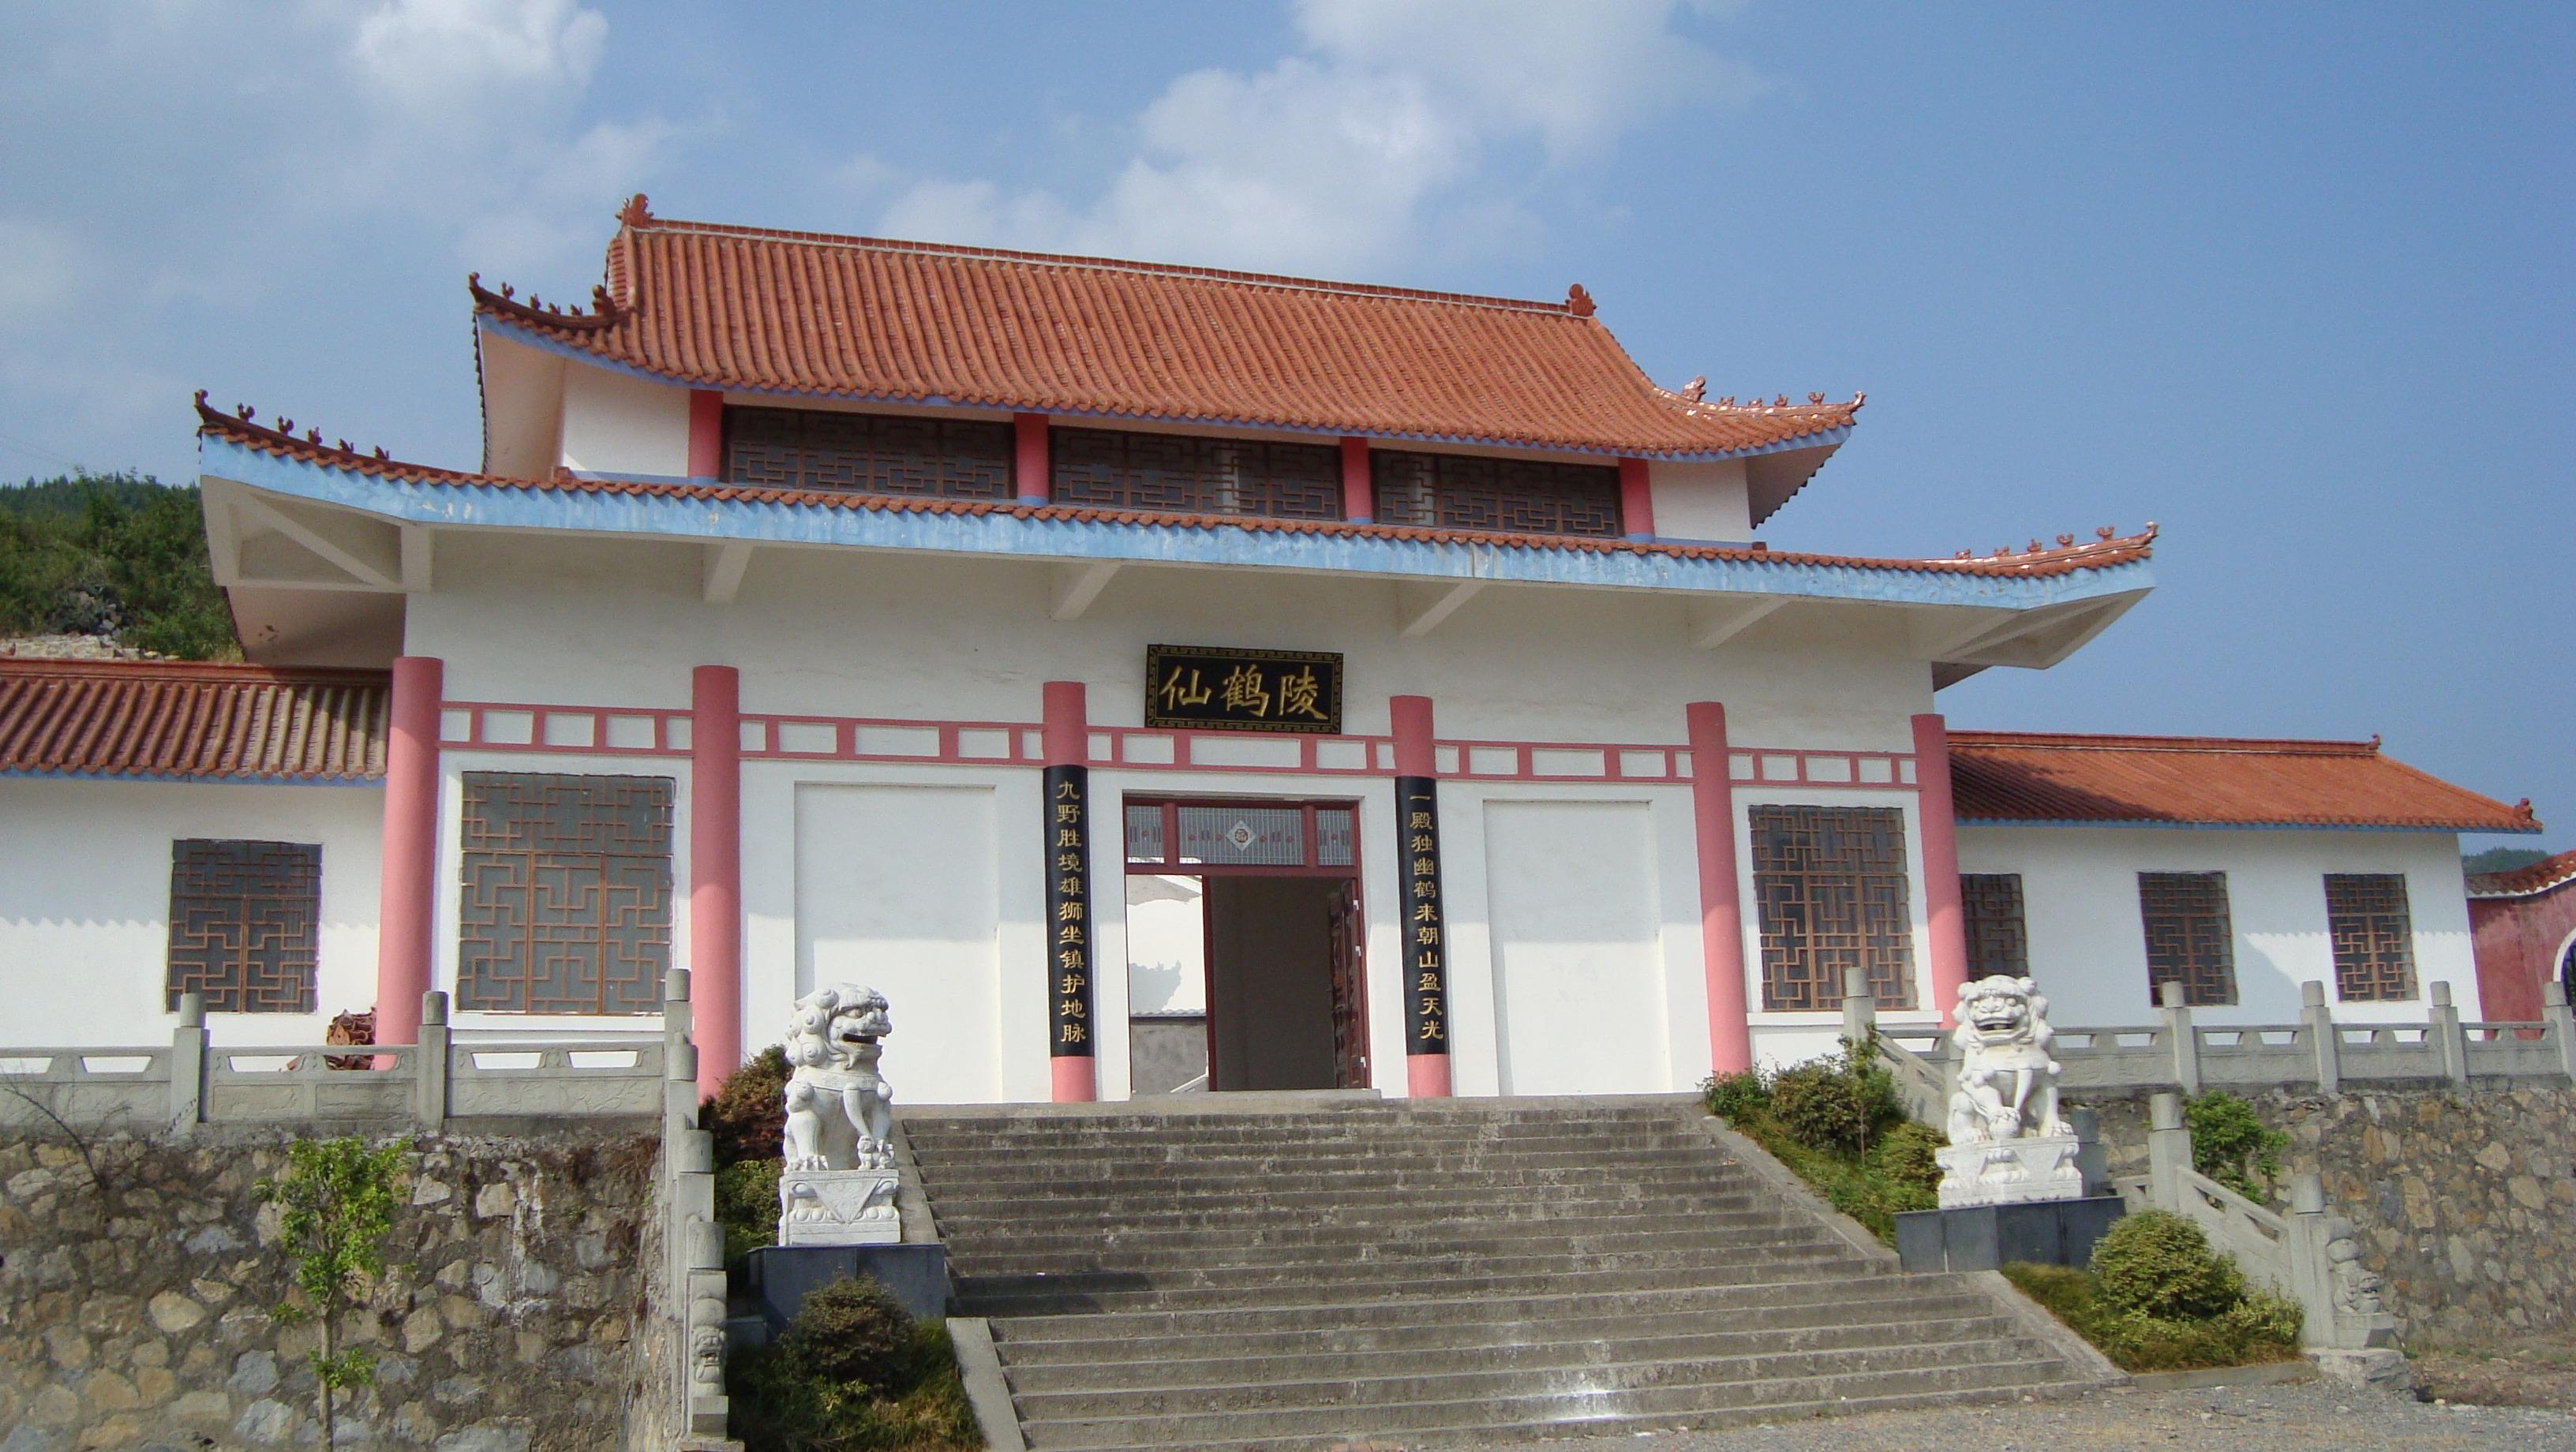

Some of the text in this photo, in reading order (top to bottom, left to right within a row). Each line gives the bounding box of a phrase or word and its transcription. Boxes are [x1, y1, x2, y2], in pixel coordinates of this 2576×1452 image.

[1159, 664, 1328, 720] 仙鹤陵
[1055, 780, 1087, 1043] 九野胜境雄狮坐镇护地脉
[1408, 795, 1444, 1039] 一殿独幽鹤来朝山盈天光
